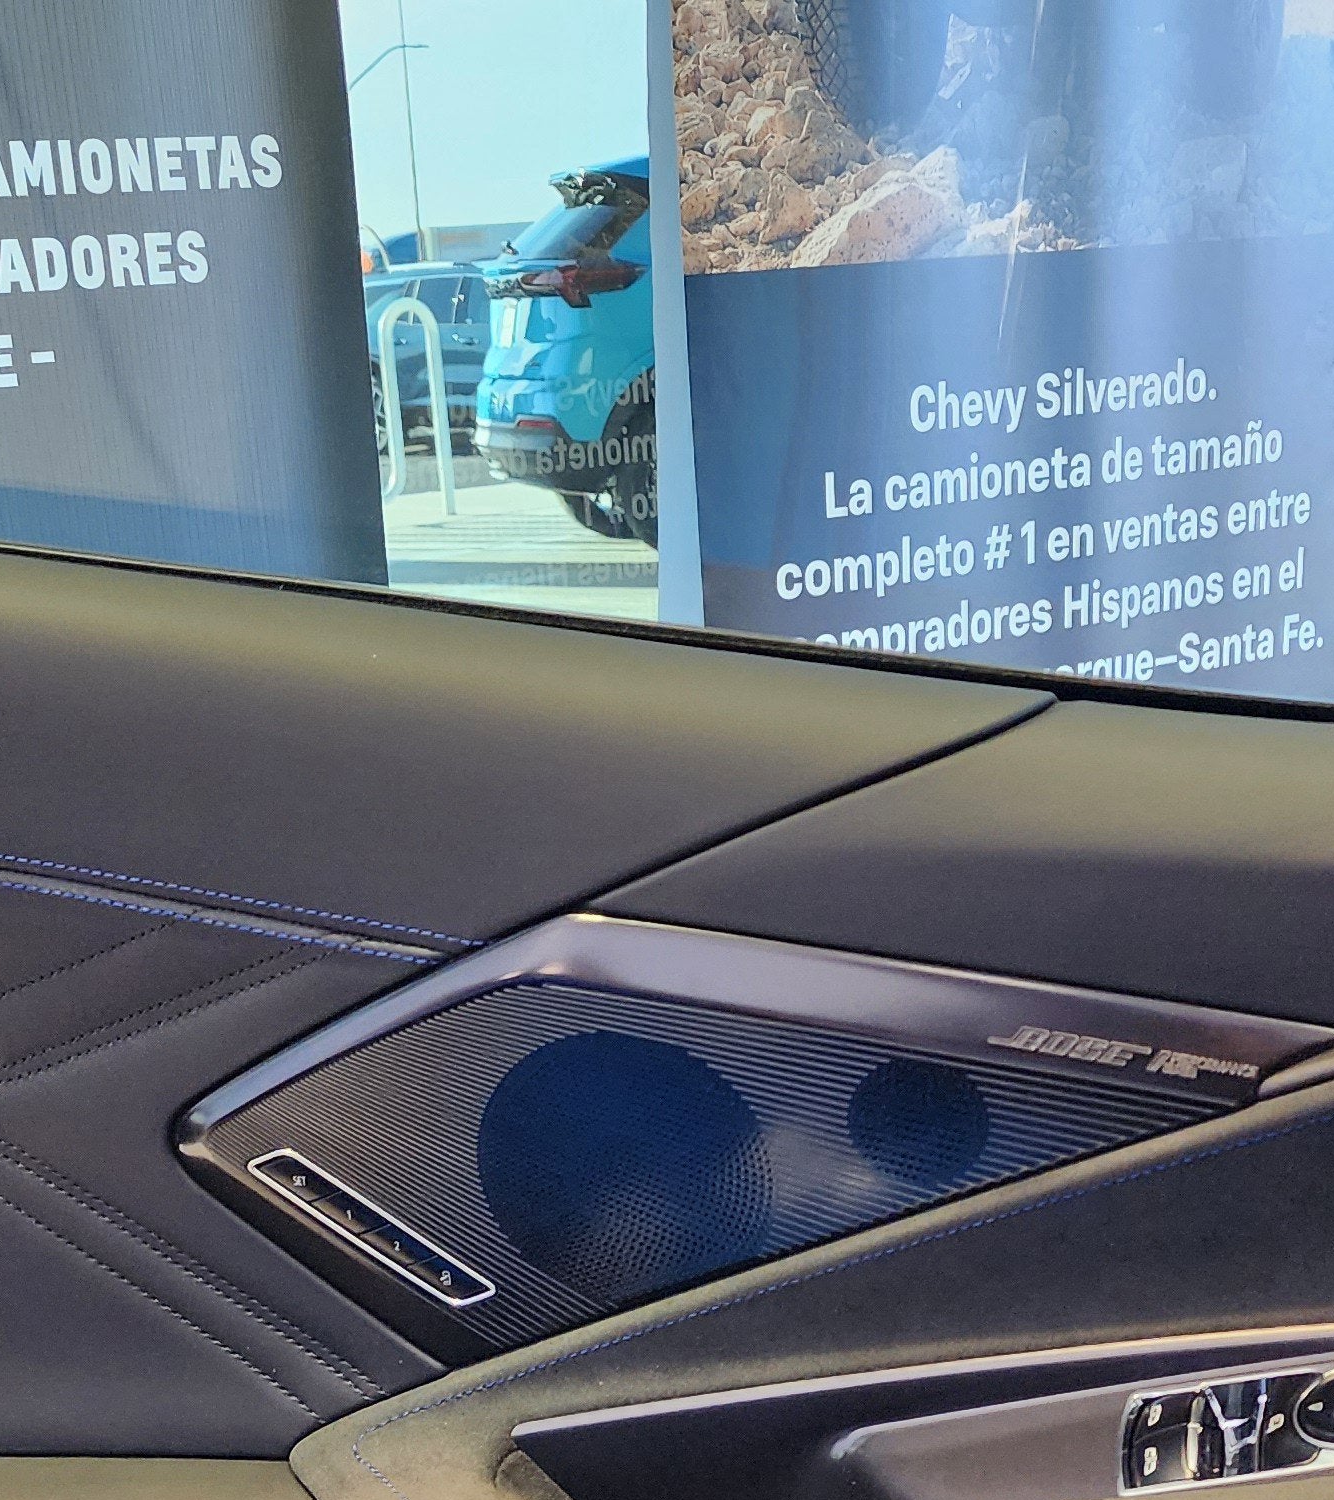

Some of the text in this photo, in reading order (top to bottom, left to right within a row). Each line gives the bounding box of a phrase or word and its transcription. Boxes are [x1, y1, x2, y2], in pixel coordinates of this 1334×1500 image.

[910, 358, 1217, 434] Chevy Silverado.
[824, 419, 1283, 519] La camioneta de tamaño
[776, 534, 975, 600] completo
[1048, 523, 1094, 562] en
[1103, 504, 1219, 554] ventas
[1228, 488, 1311, 535] entre
[795, 546, 1305, 657] mpradores Hispanos en el
[1282, 613, 1324, 656] Fe.
[986, 1024, 1154, 1068] BOSE
[291, 1174, 308, 1188] SET
[392, 1240, 402, 1252] 2
